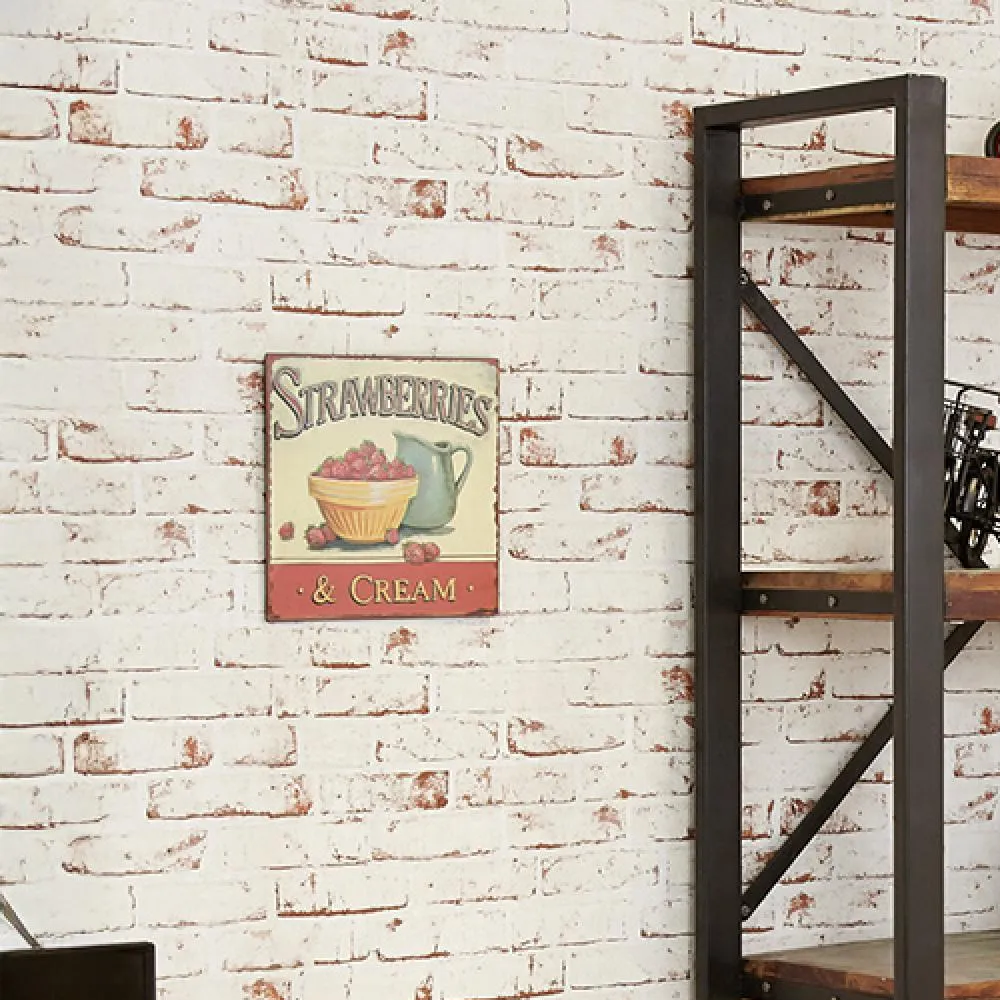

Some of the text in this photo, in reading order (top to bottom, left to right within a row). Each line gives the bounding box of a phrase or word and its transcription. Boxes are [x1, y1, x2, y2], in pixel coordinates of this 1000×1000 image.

[272, 366, 493, 440] STRAWBERRIES
[312, 574, 456, 606] & CREAM
